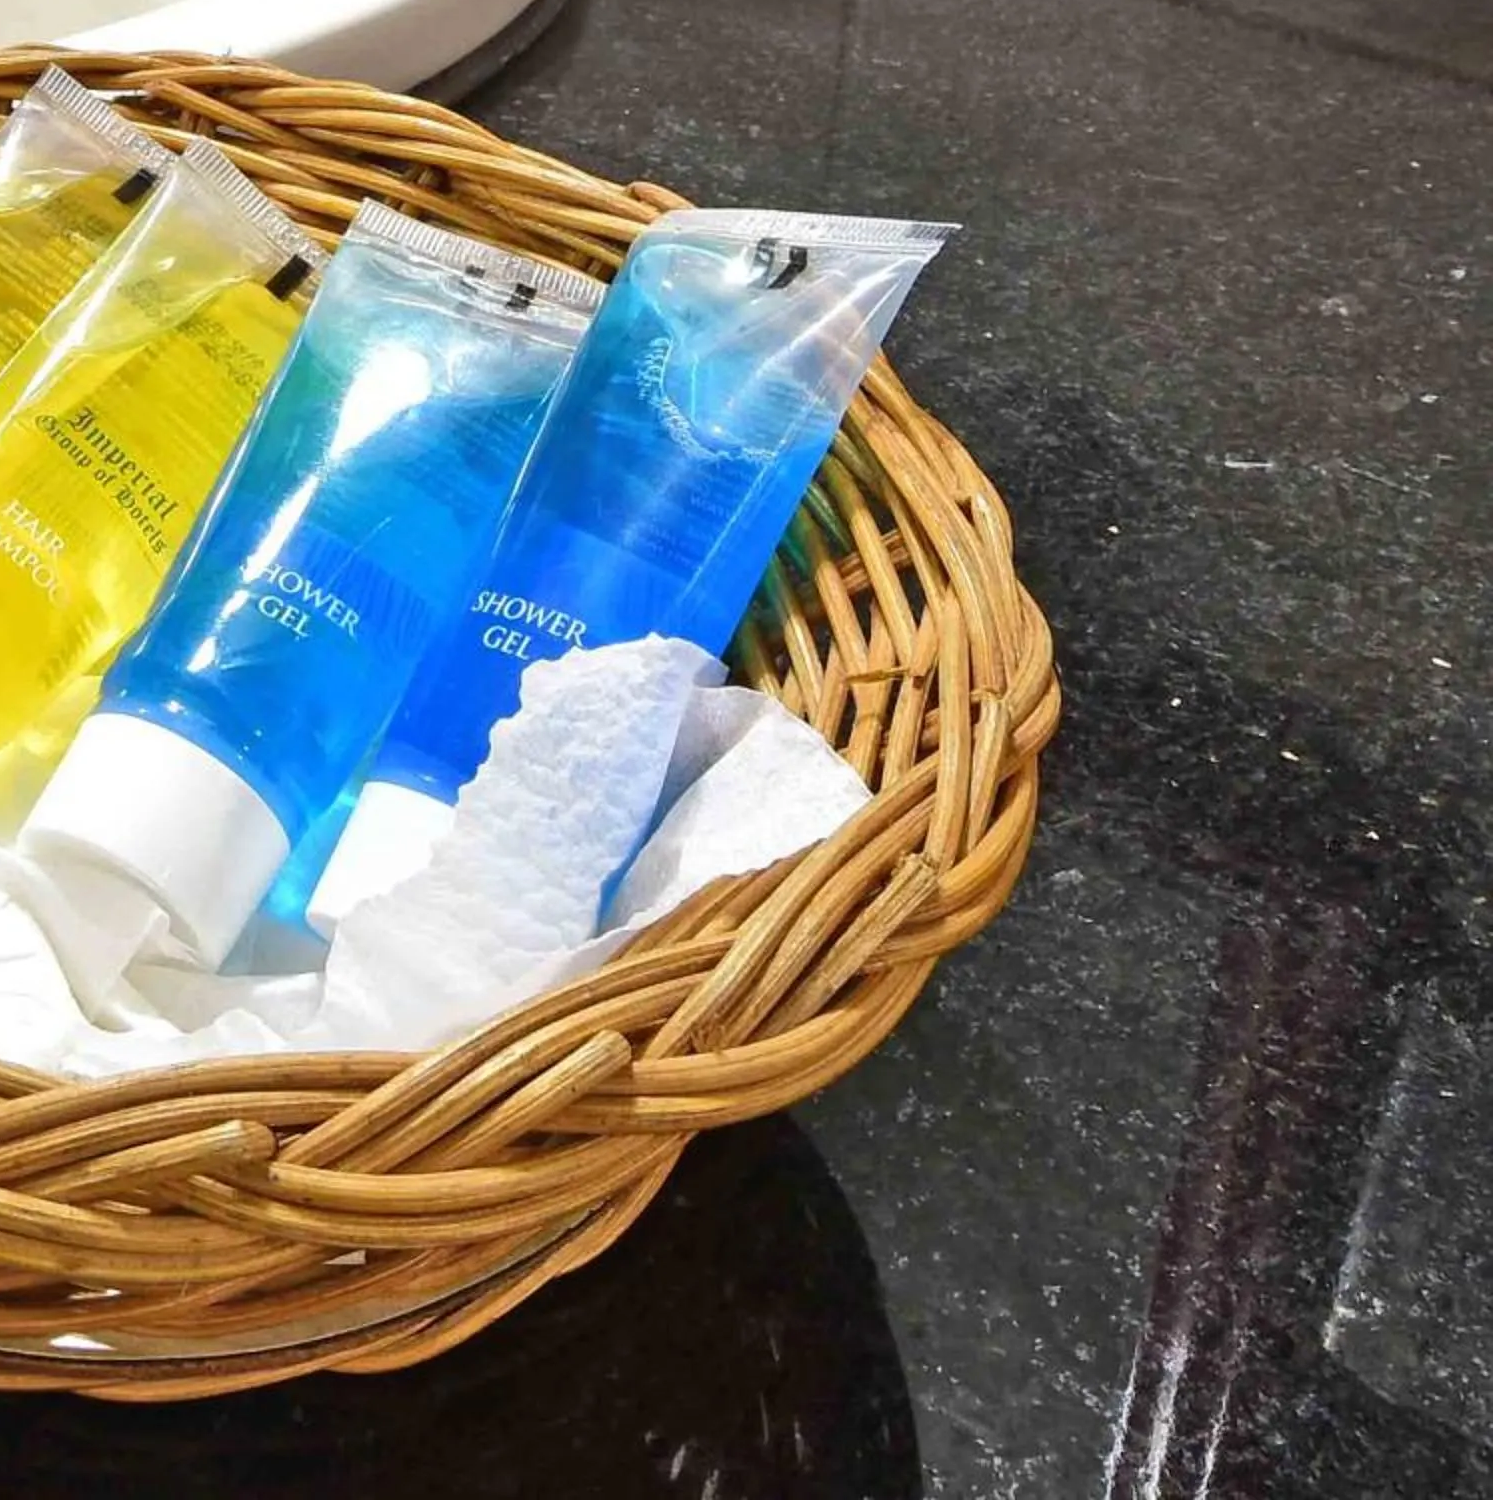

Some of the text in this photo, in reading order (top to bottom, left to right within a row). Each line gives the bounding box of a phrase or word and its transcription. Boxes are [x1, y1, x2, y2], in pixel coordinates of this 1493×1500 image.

[66, 406, 179, 522] Imperial
[93, 468, 118, 489] of
[1, 499, 66, 556] HAIR
[238, 558, 360, 643] HOWER
[258, 595, 311, 638] GEL
[470, 590, 587, 648] SHOWER
[482, 624, 533, 661] GEL
